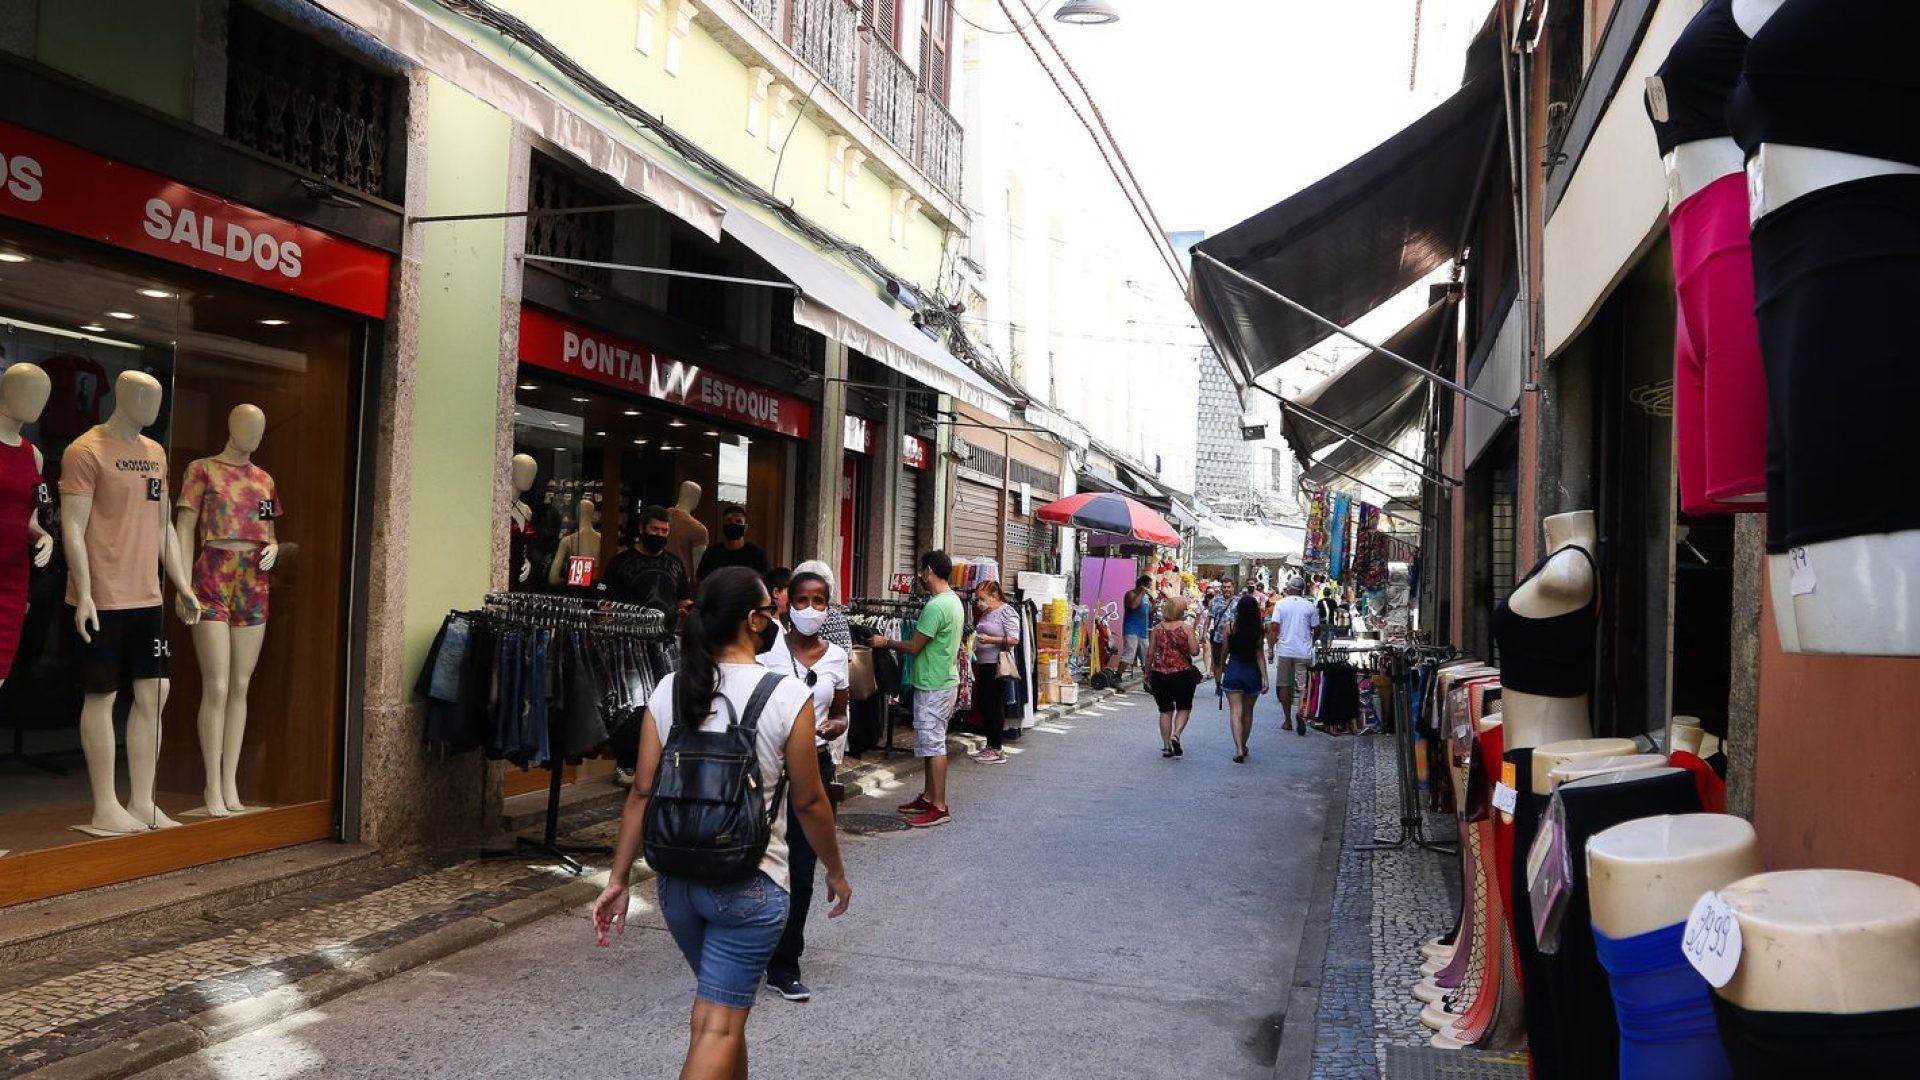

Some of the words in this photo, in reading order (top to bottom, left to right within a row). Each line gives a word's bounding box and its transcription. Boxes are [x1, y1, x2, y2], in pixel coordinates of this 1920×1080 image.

[0, 152, 43, 202] S
[143, 198, 302, 278] SALDOS
[562, 331, 645, 384] PONTA
[701, 377, 779, 423] ESTOQUE
